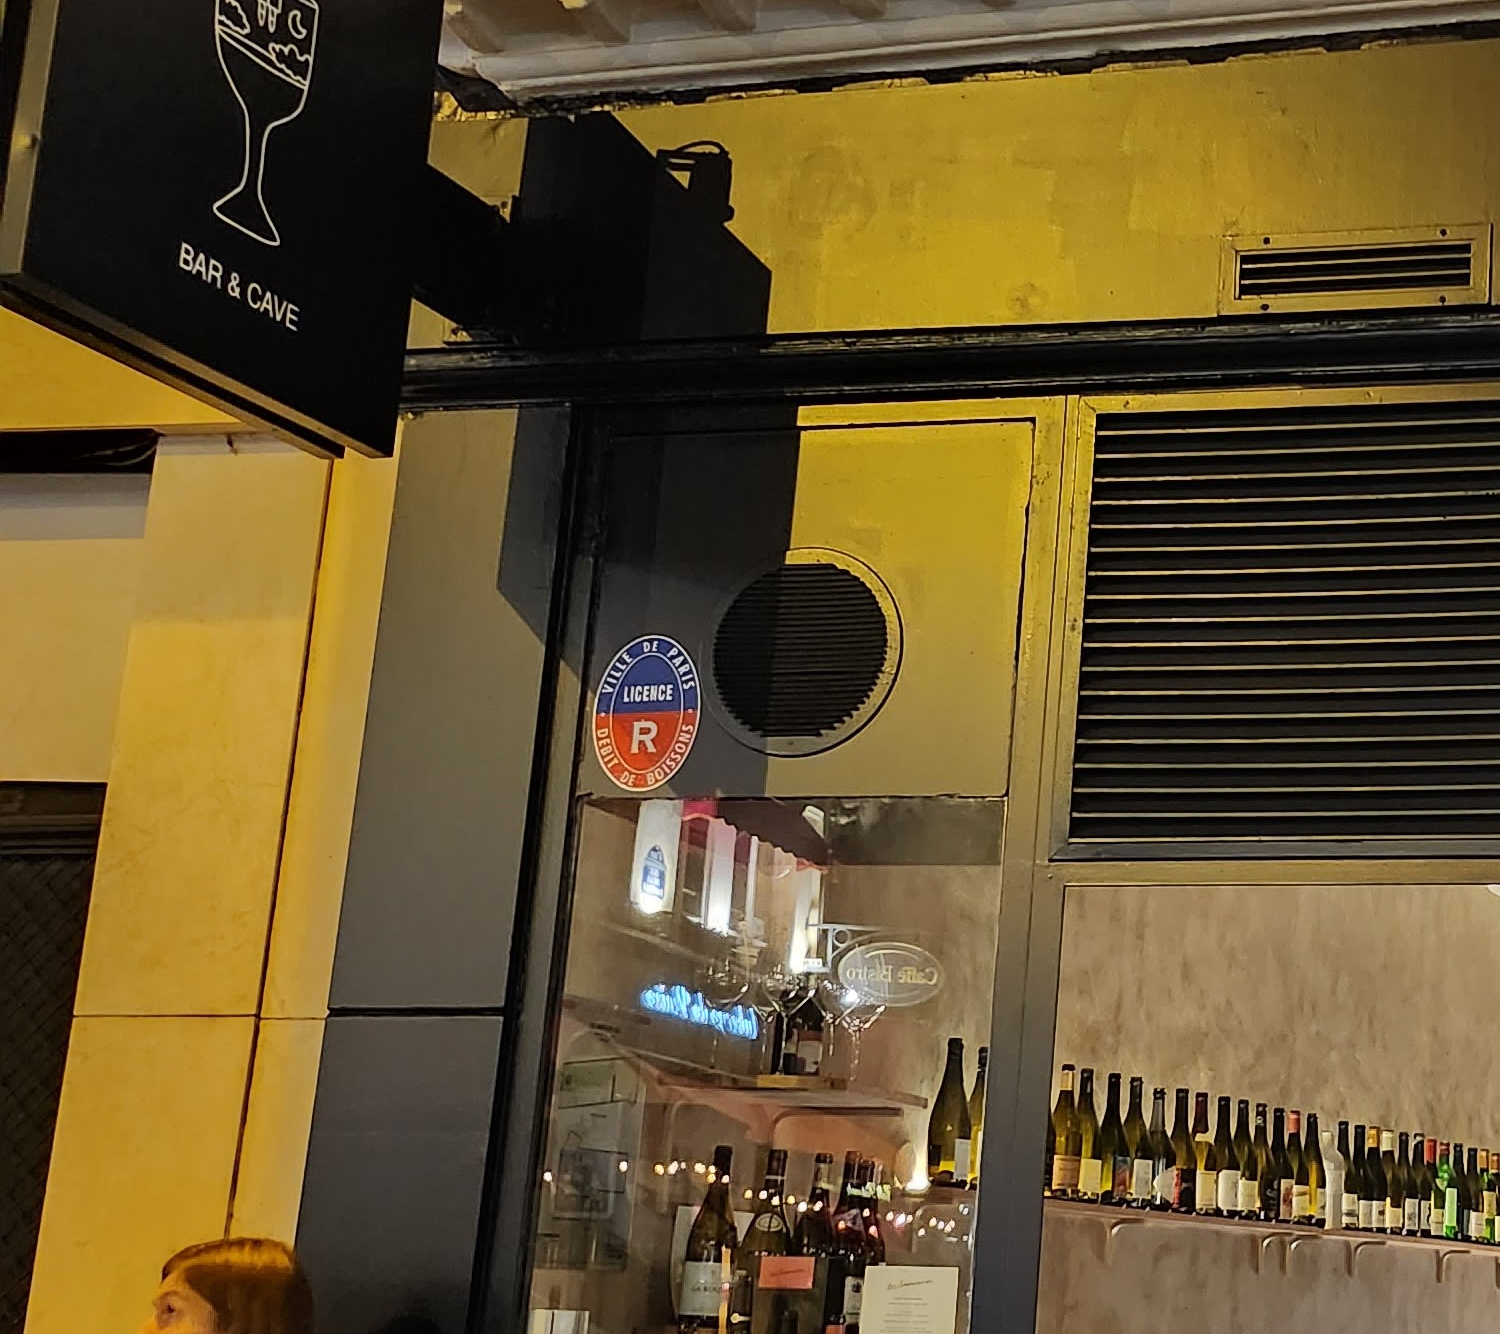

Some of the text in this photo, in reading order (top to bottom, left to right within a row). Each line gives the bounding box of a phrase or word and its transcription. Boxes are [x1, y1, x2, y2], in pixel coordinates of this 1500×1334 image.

[179, 242, 300, 332] BAR & CAVE
[601, 640, 696, 694] VILLE DE PARIS
[623, 684, 674, 703] LICENCE
[597, 723, 694, 787] DEBIT DE BOISSONS
[630, 720, 659, 754] R
